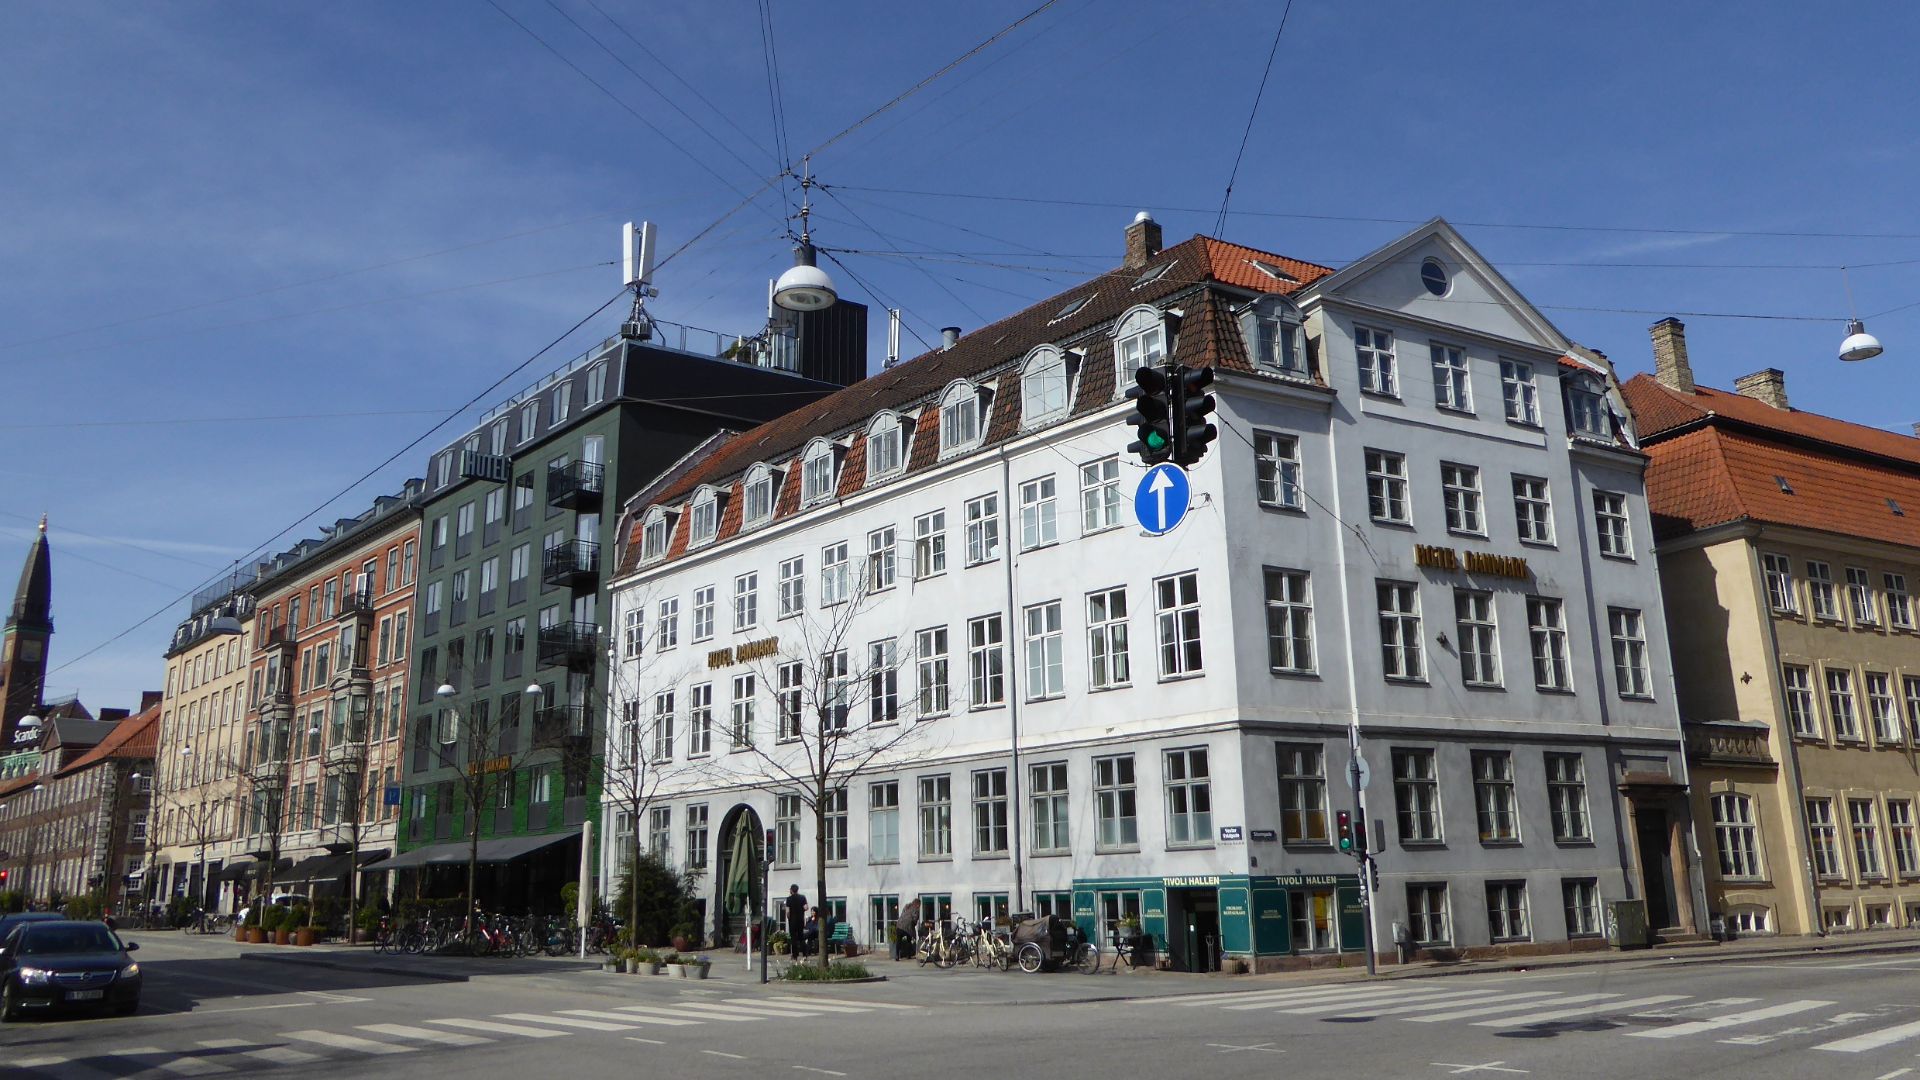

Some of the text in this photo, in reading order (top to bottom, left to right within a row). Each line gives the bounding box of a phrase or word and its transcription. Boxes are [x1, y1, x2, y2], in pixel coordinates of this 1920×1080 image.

[1413, 543, 1527, 578] HOTEL DANMARK
[708, 636, 779, 668] HOTEL DANMARK
[14, 726, 38, 743] Scandic
[1162, 876, 1220, 886] TIVOLI HALLEN
[1276, 875, 1337, 885] TIVOLI HALLEN
